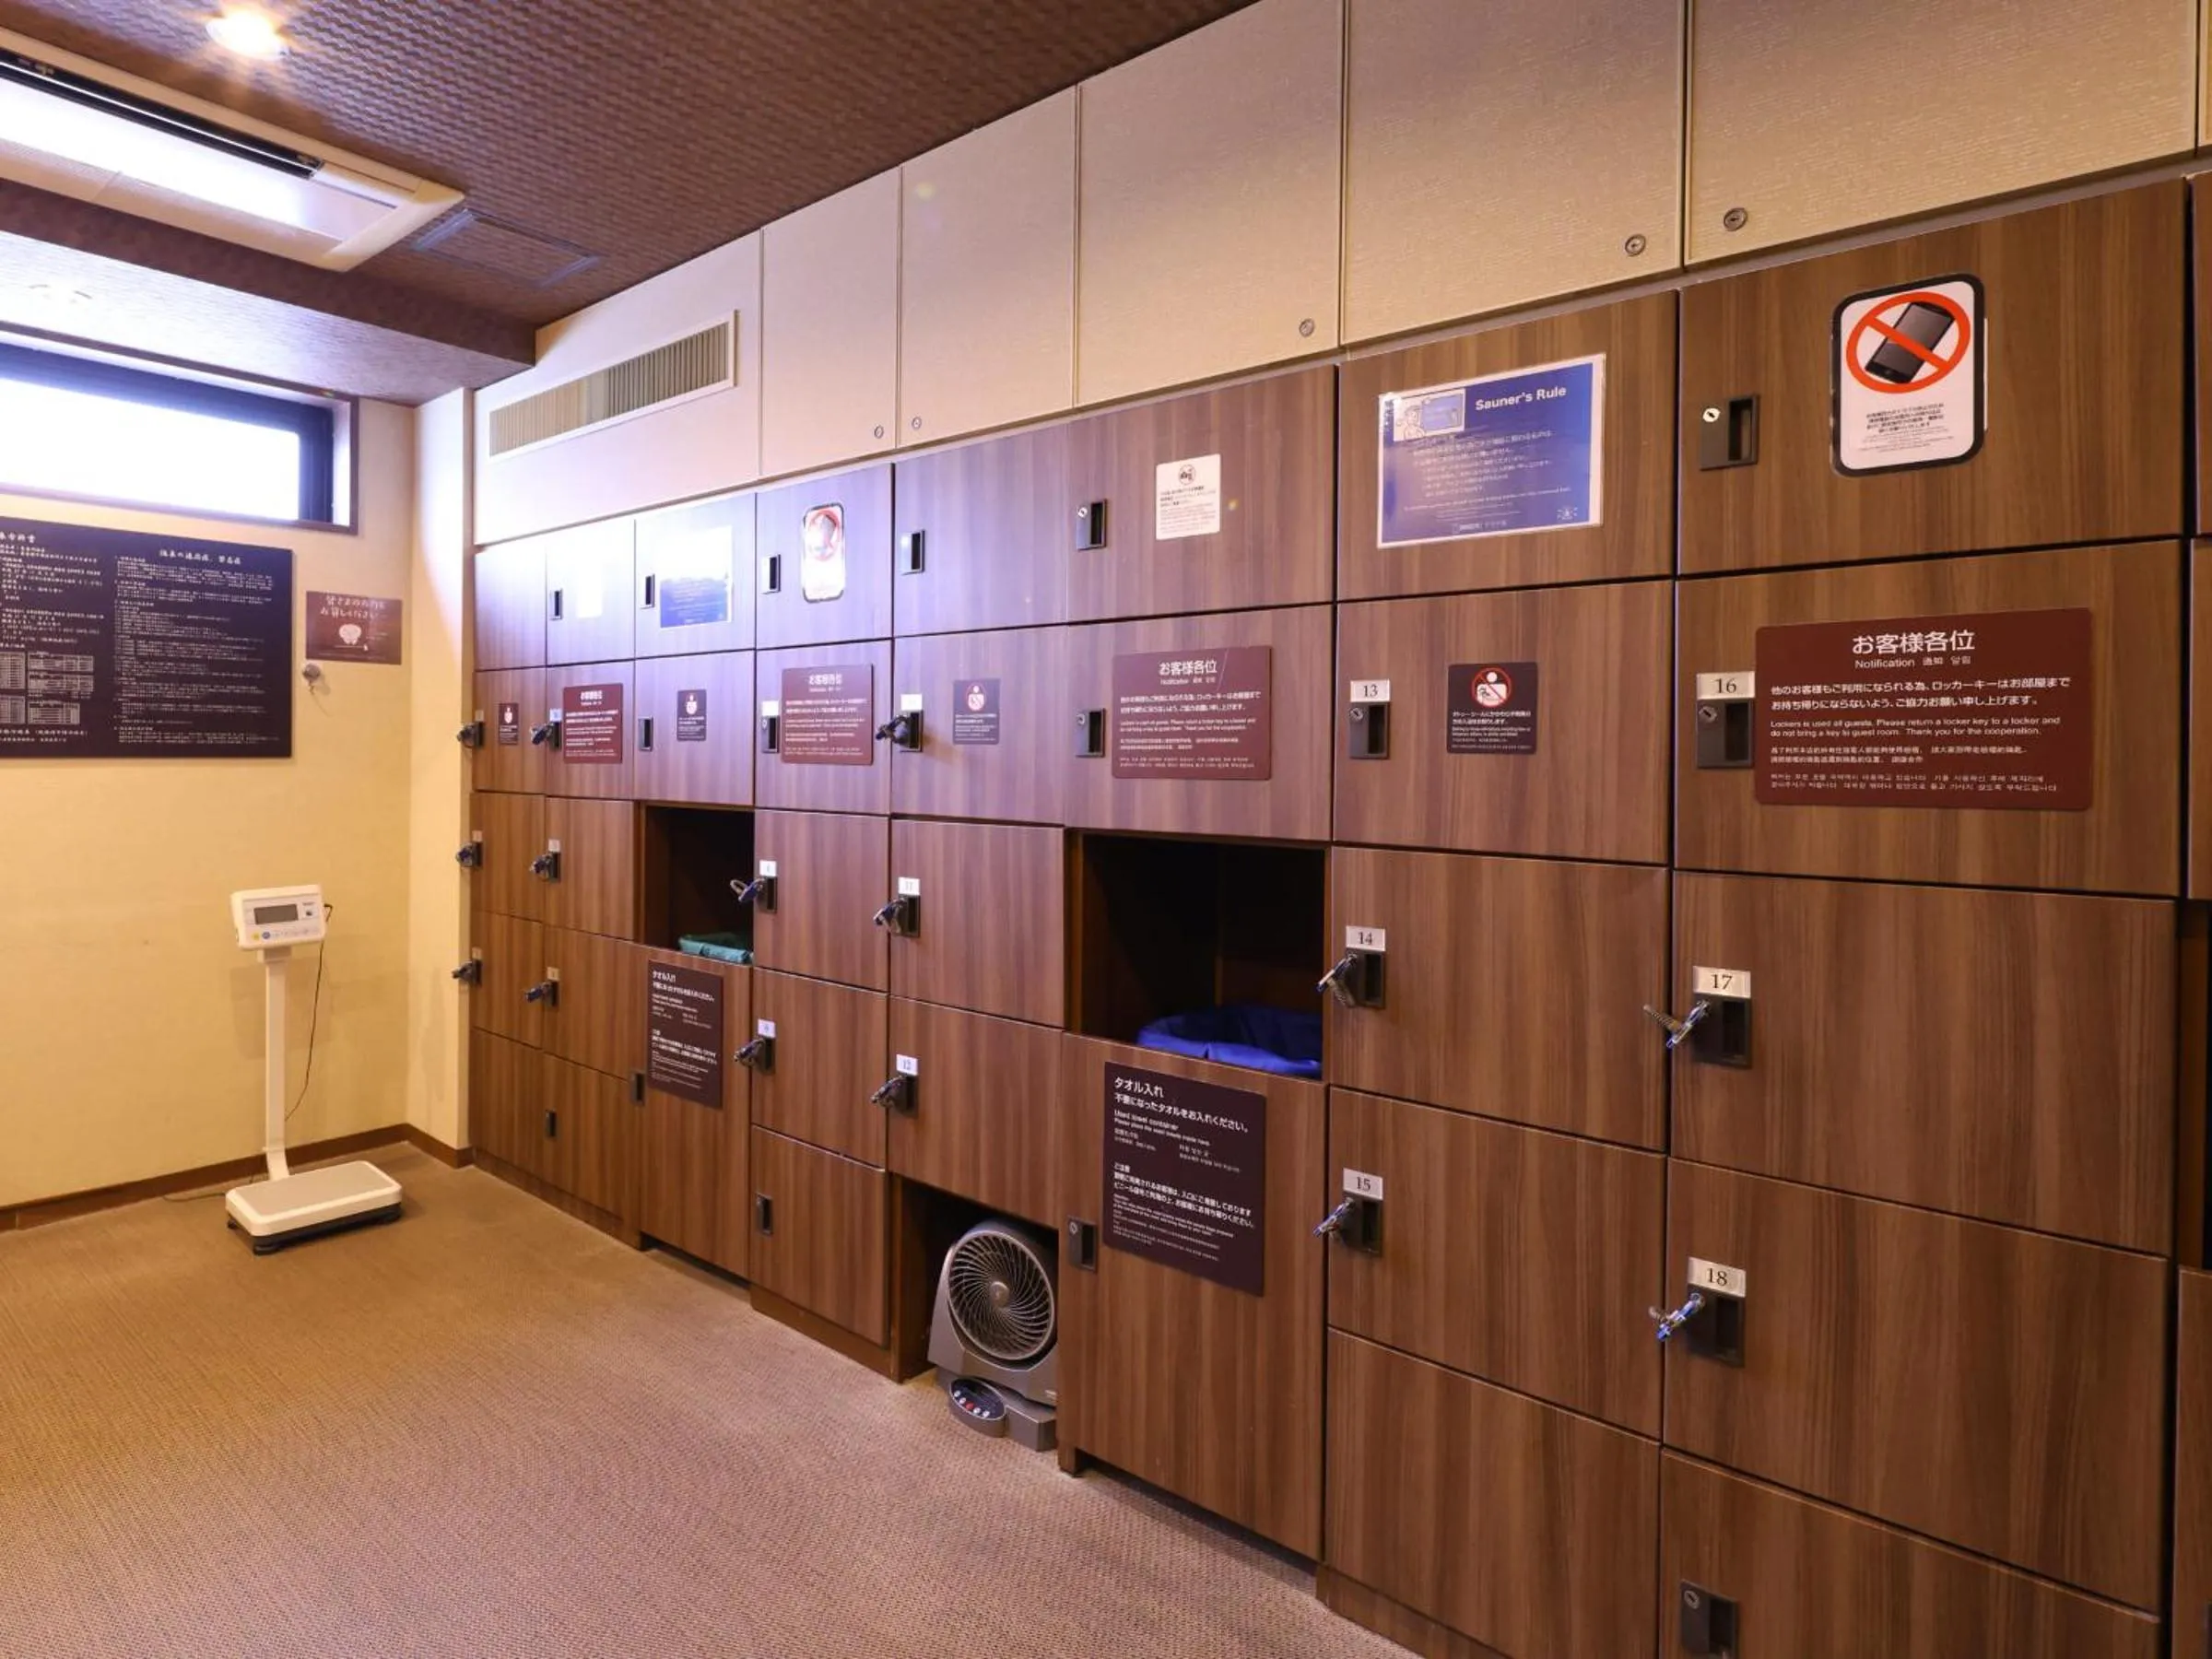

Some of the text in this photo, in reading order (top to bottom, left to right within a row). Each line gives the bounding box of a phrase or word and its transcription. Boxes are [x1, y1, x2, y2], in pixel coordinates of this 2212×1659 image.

[1475, 385, 1567, 411] Sauner's Rule
[1852, 629, 1975, 654] お客様各位
[1159, 660, 1218, 676] お客様各位
[1854, 658, 1915, 669] Notification
[1362, 684, 1378, 697] 13
[1714, 677, 1737, 693] 16
[1877, 718, 1905, 726] Please
[1908, 718, 1934, 726] return
[1972, 717, 1989, 726] key
[2011, 717, 2040, 725] locker
[2041, 716, 2061, 724] and
[1852, 727, 1875, 738] guest
[1906, 727, 1932, 735] Thank
[1936, 728, 1951, 736] you
[1953, 727, 1965, 735] for
[1967, 727, 1982, 735] the
[1358, 932, 1372, 945] 14
[1712, 973, 1733, 990] 17
[1114, 1077, 1164, 1098] タオル入れ
[1357, 1176, 1371, 1192] 15
[1707, 1267, 1728, 1286] 18
